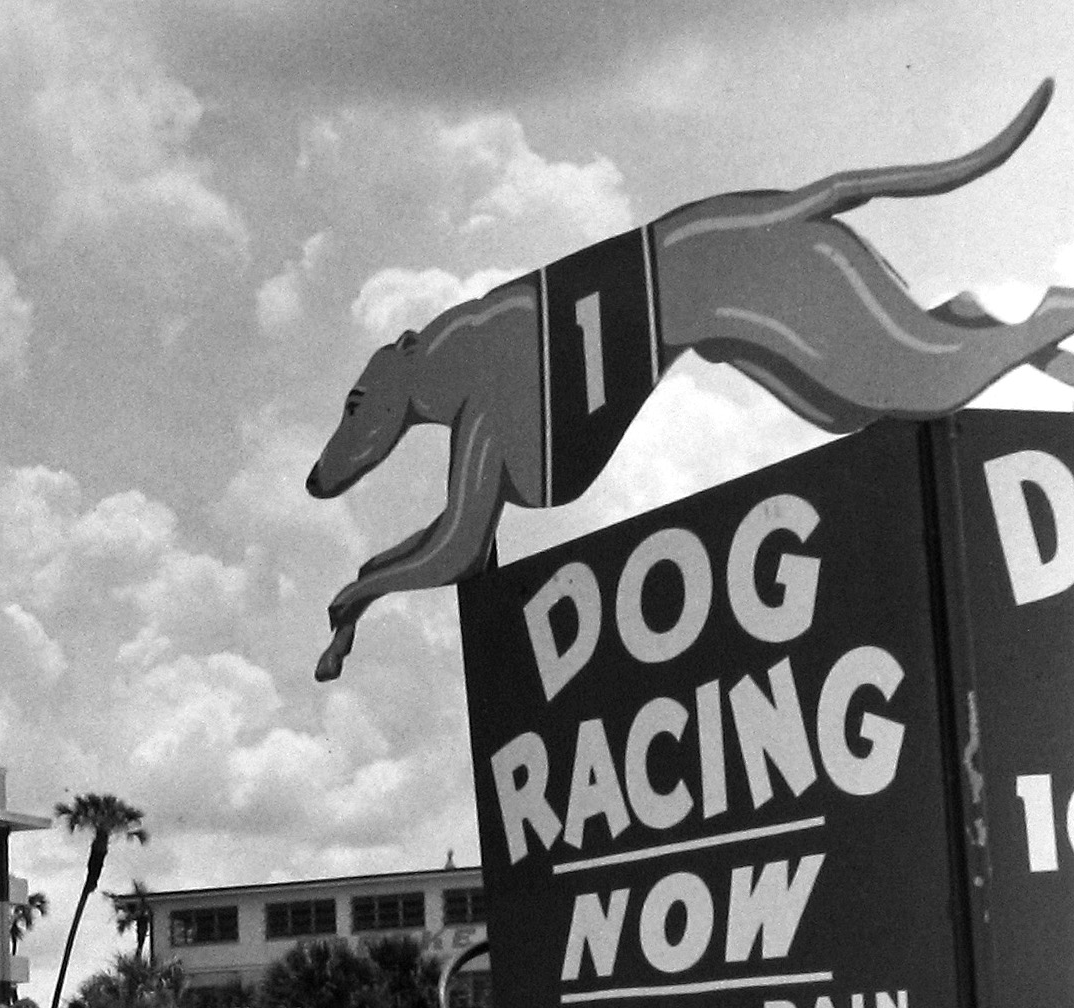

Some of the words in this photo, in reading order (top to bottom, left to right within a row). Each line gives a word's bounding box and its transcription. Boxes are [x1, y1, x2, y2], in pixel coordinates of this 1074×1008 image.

[575, 291, 607, 415] 1
[524, 494, 822, 702] DOG
[490, 645, 906, 866] RACING
[561, 853, 826, 981] NOW
